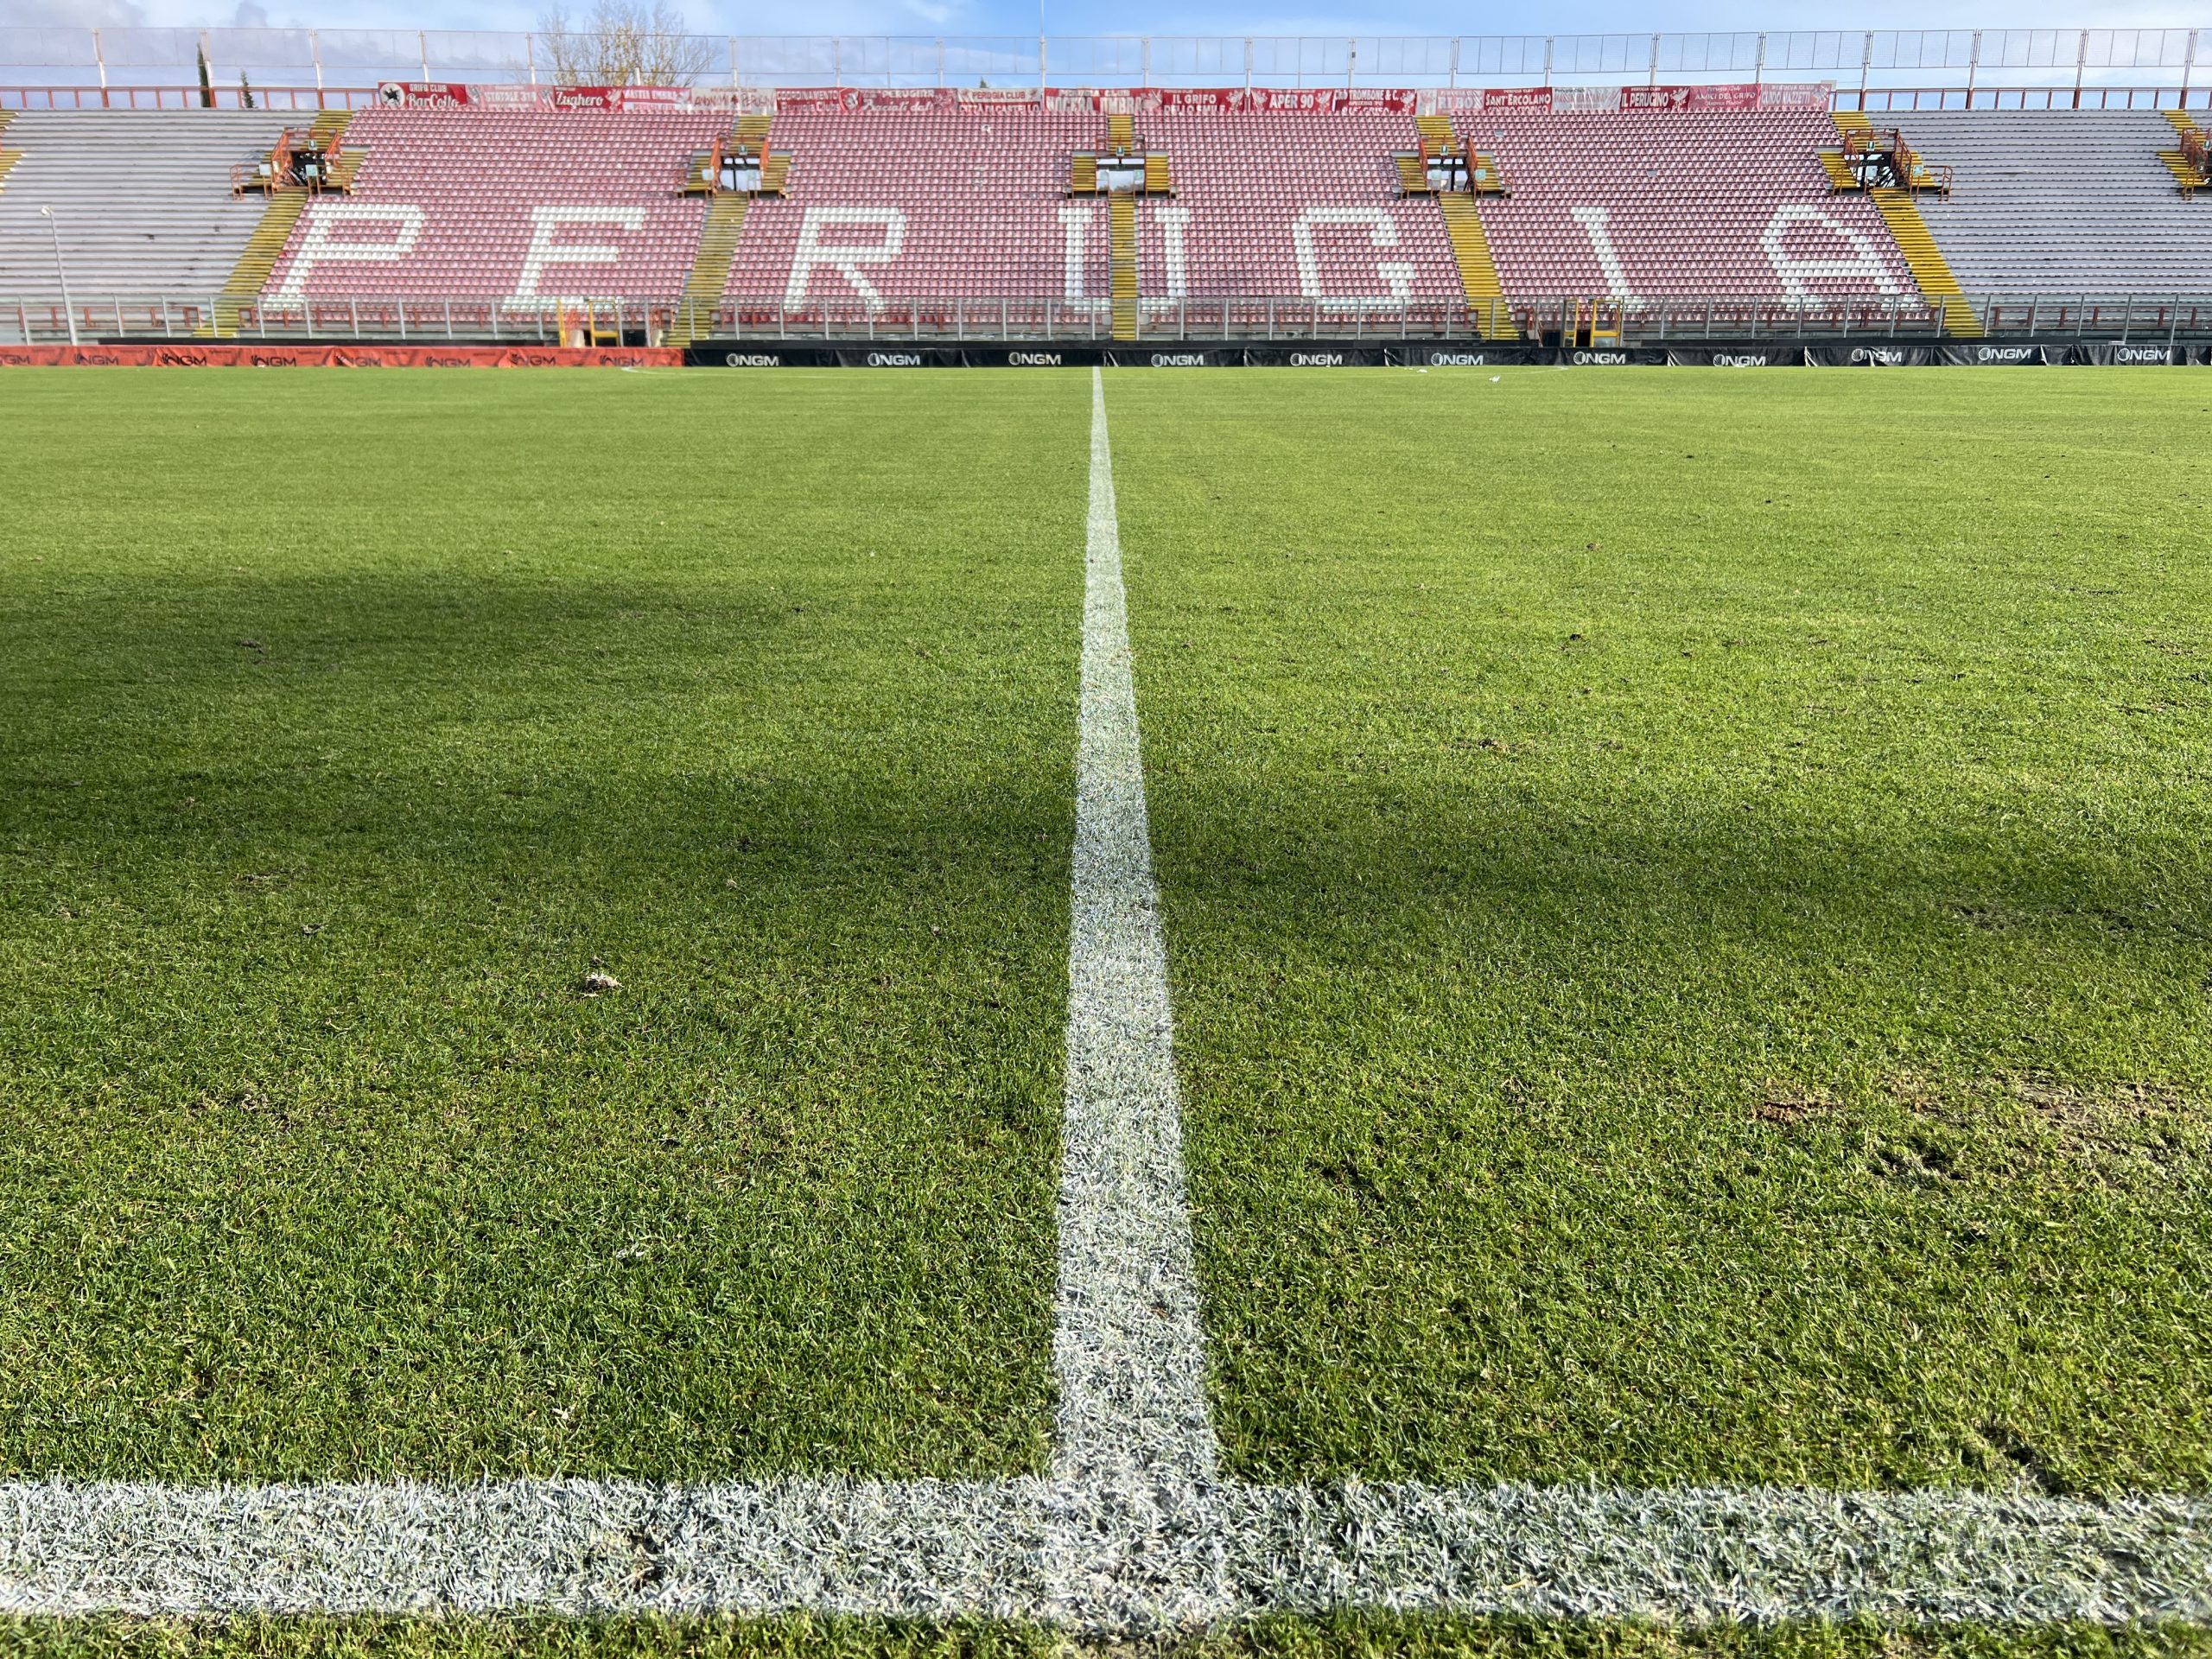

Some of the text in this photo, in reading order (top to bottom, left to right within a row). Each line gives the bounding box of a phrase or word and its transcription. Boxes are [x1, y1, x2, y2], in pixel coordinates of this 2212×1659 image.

[1173, 94, 1217, 105] IL GRIFO
[1300, 94, 1314, 109] 90
[1621, 92, 1669, 107] IL PERUGINO
[259, 202, 1925, 315] PERUGIA
